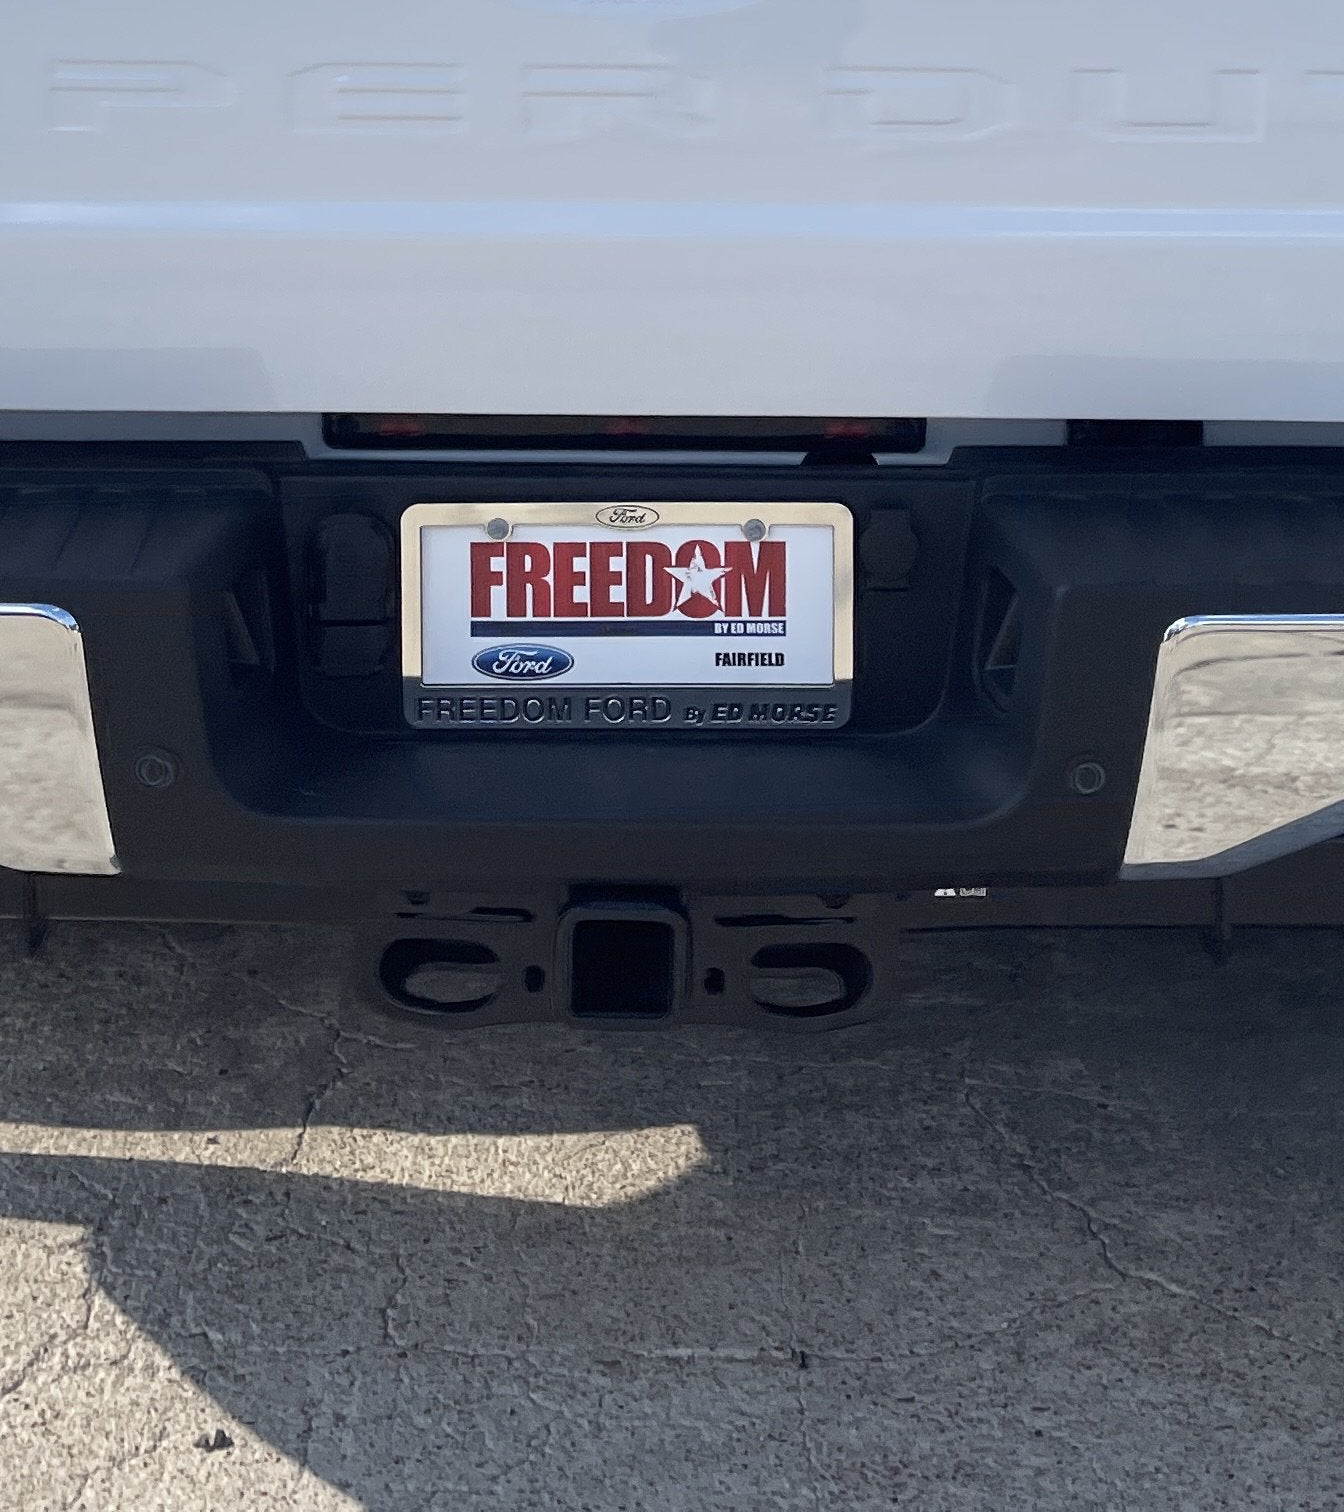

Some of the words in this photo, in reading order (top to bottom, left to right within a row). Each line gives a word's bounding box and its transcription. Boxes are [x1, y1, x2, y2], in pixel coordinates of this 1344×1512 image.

[470, 540, 786, 618] FREEDOM
[714, 622, 729, 634] BY
[730, 622, 744, 634] ED
[746, 622, 784, 634] MORSE
[492, 649, 555, 675] Ford
[714, 652, 785, 667] FAIRFIELD
[416, 695, 572, 724] FREEDOM
[584, 695, 672, 724] FORD
[711, 702, 745, 724] ED
[748, 702, 839, 724] MORSE
